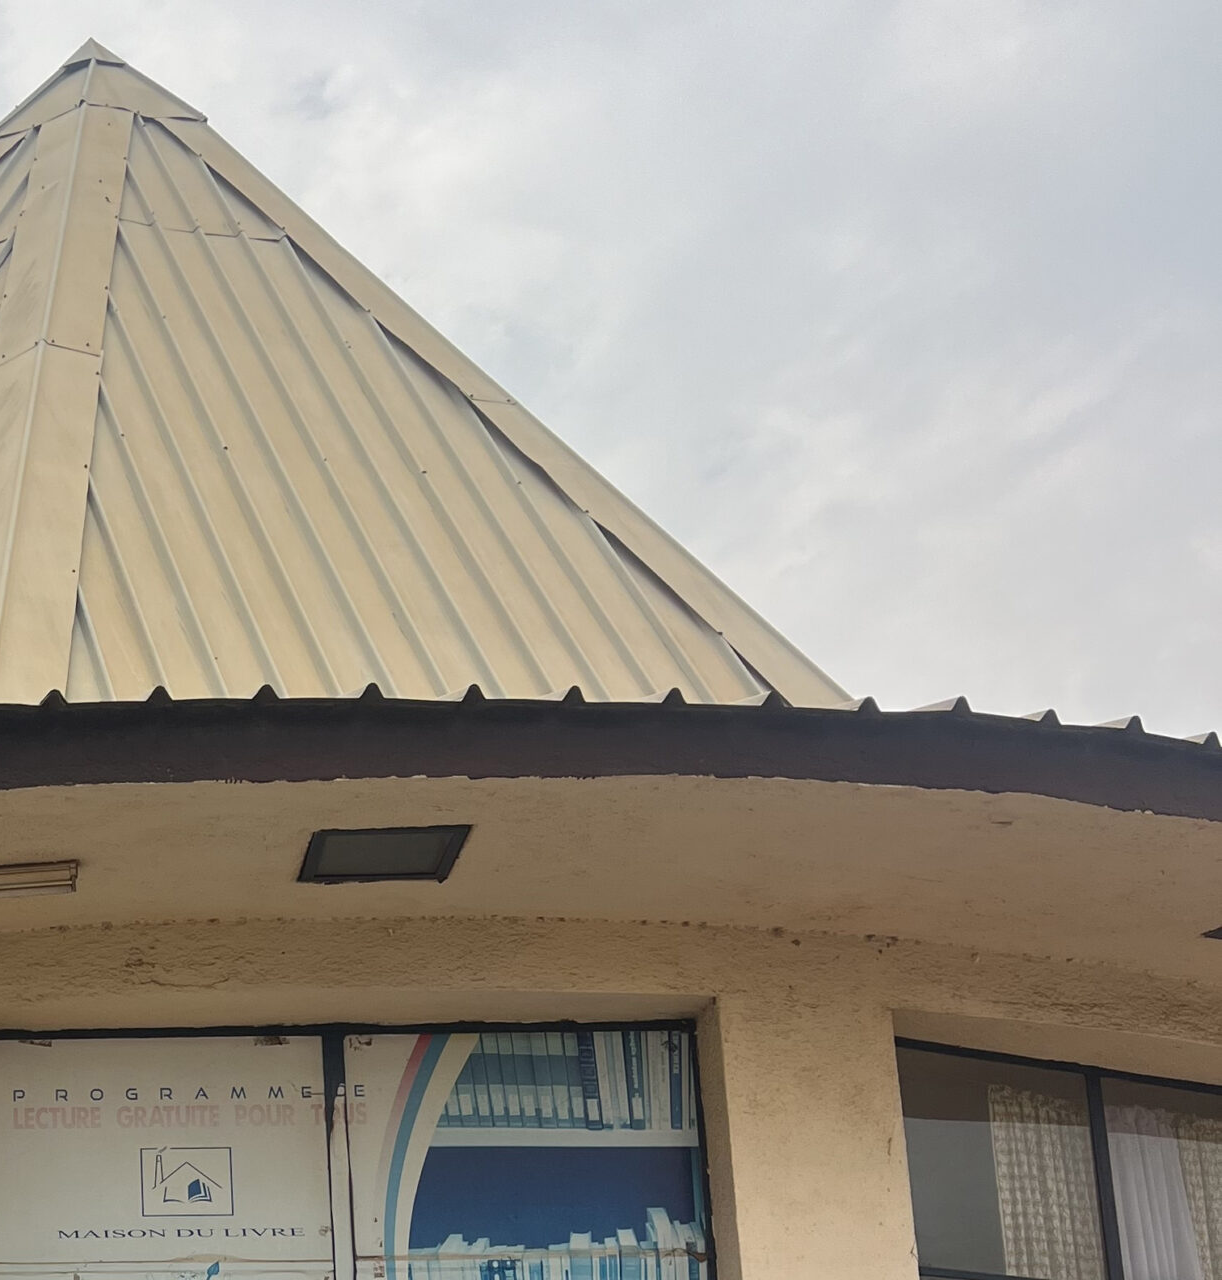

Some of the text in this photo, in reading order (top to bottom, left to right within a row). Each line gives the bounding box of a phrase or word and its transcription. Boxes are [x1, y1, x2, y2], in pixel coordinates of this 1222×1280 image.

[12, 1084, 365, 1102] PROGRAMME DE
[12, 1106, 101, 1130] LECTURE
[116, 1104, 220, 1129] GRATUITE
[234, 1104, 296, 1127] POUR
[58, 1227, 305, 1239] MAISON DU LIVRE
